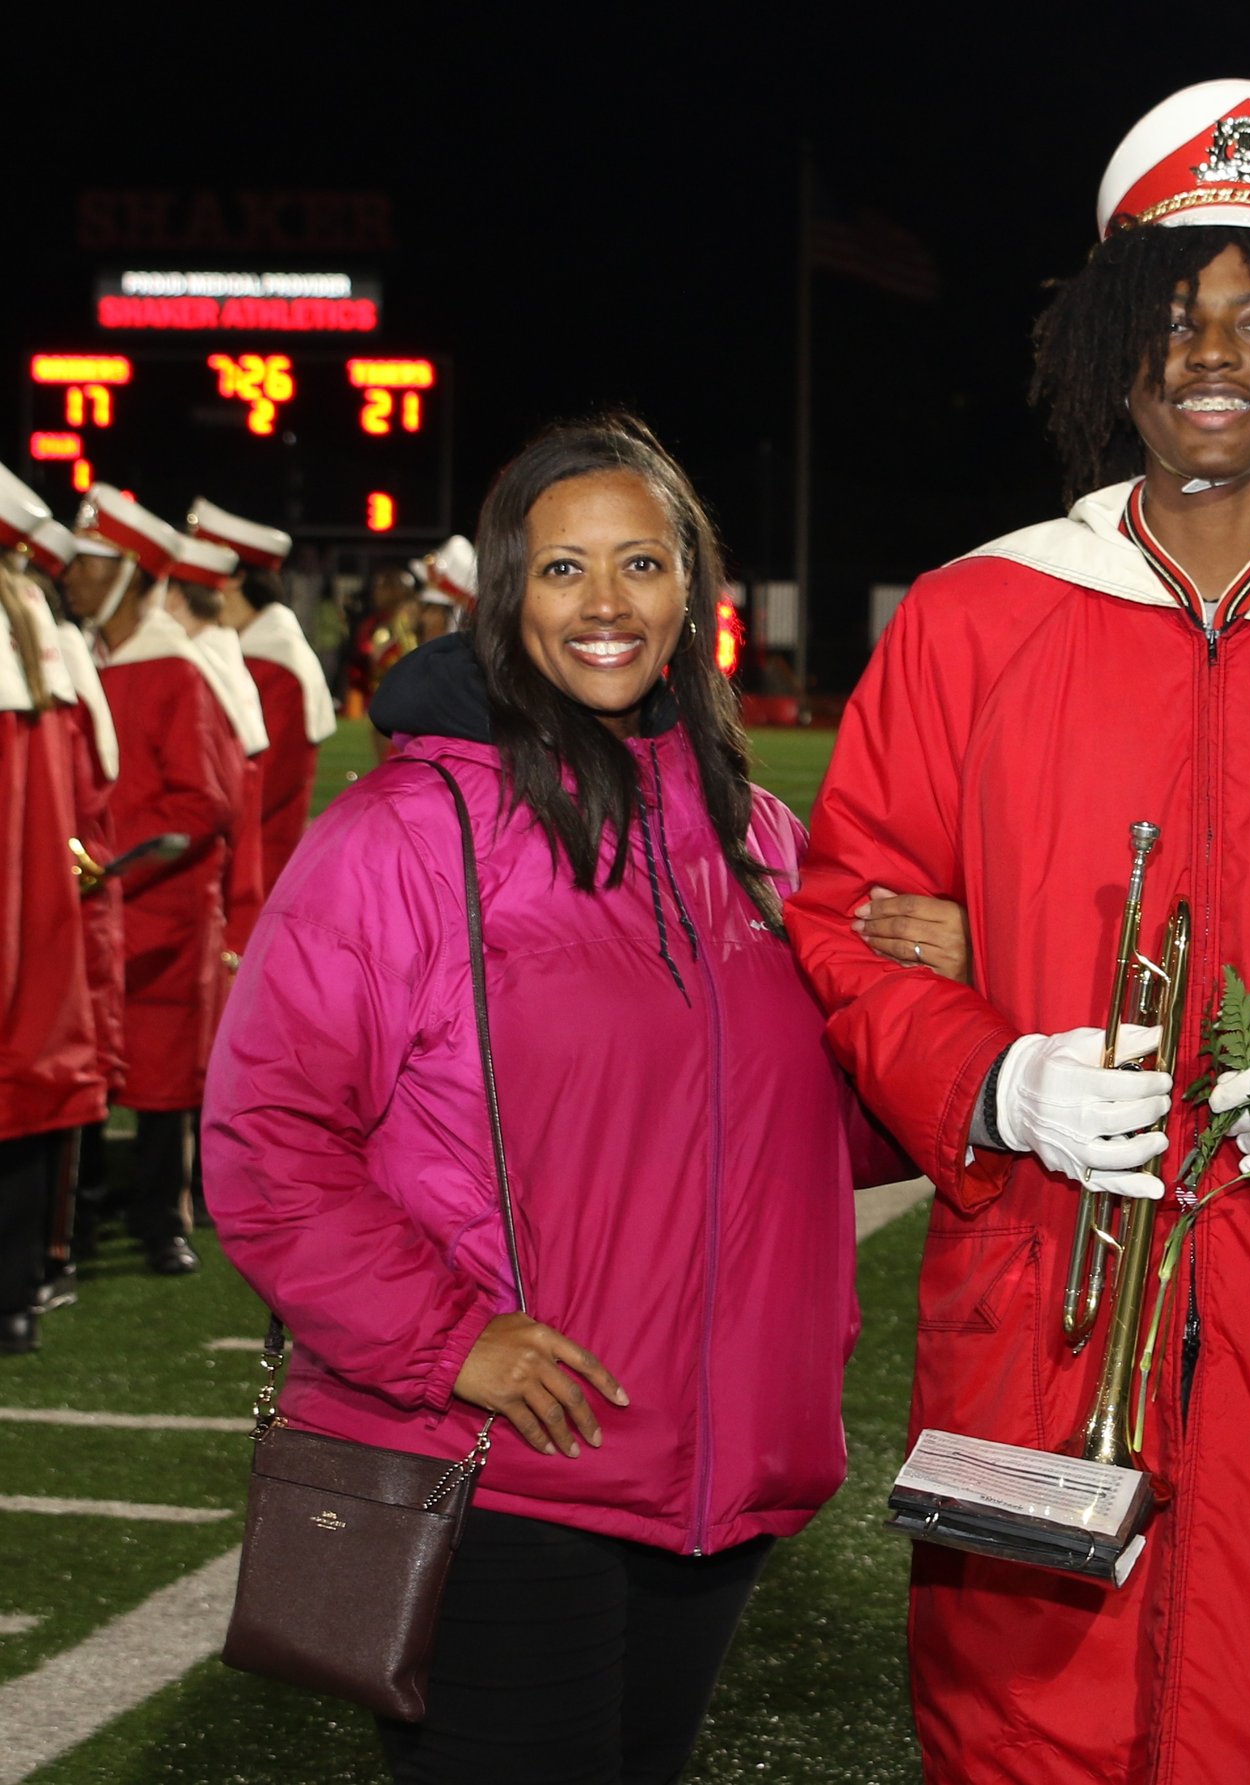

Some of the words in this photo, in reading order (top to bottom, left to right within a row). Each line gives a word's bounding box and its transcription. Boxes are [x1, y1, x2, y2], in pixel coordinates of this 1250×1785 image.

[77, 190, 397, 252] SHAKER
[122, 272, 187, 294] PROUD
[97, 297, 219, 329] SHAKER
[221, 298, 377, 332] ATHLETICS
[66, 384, 111, 427] 17
[249, 398, 275, 435] 2
[362, 387, 420, 434] 21
